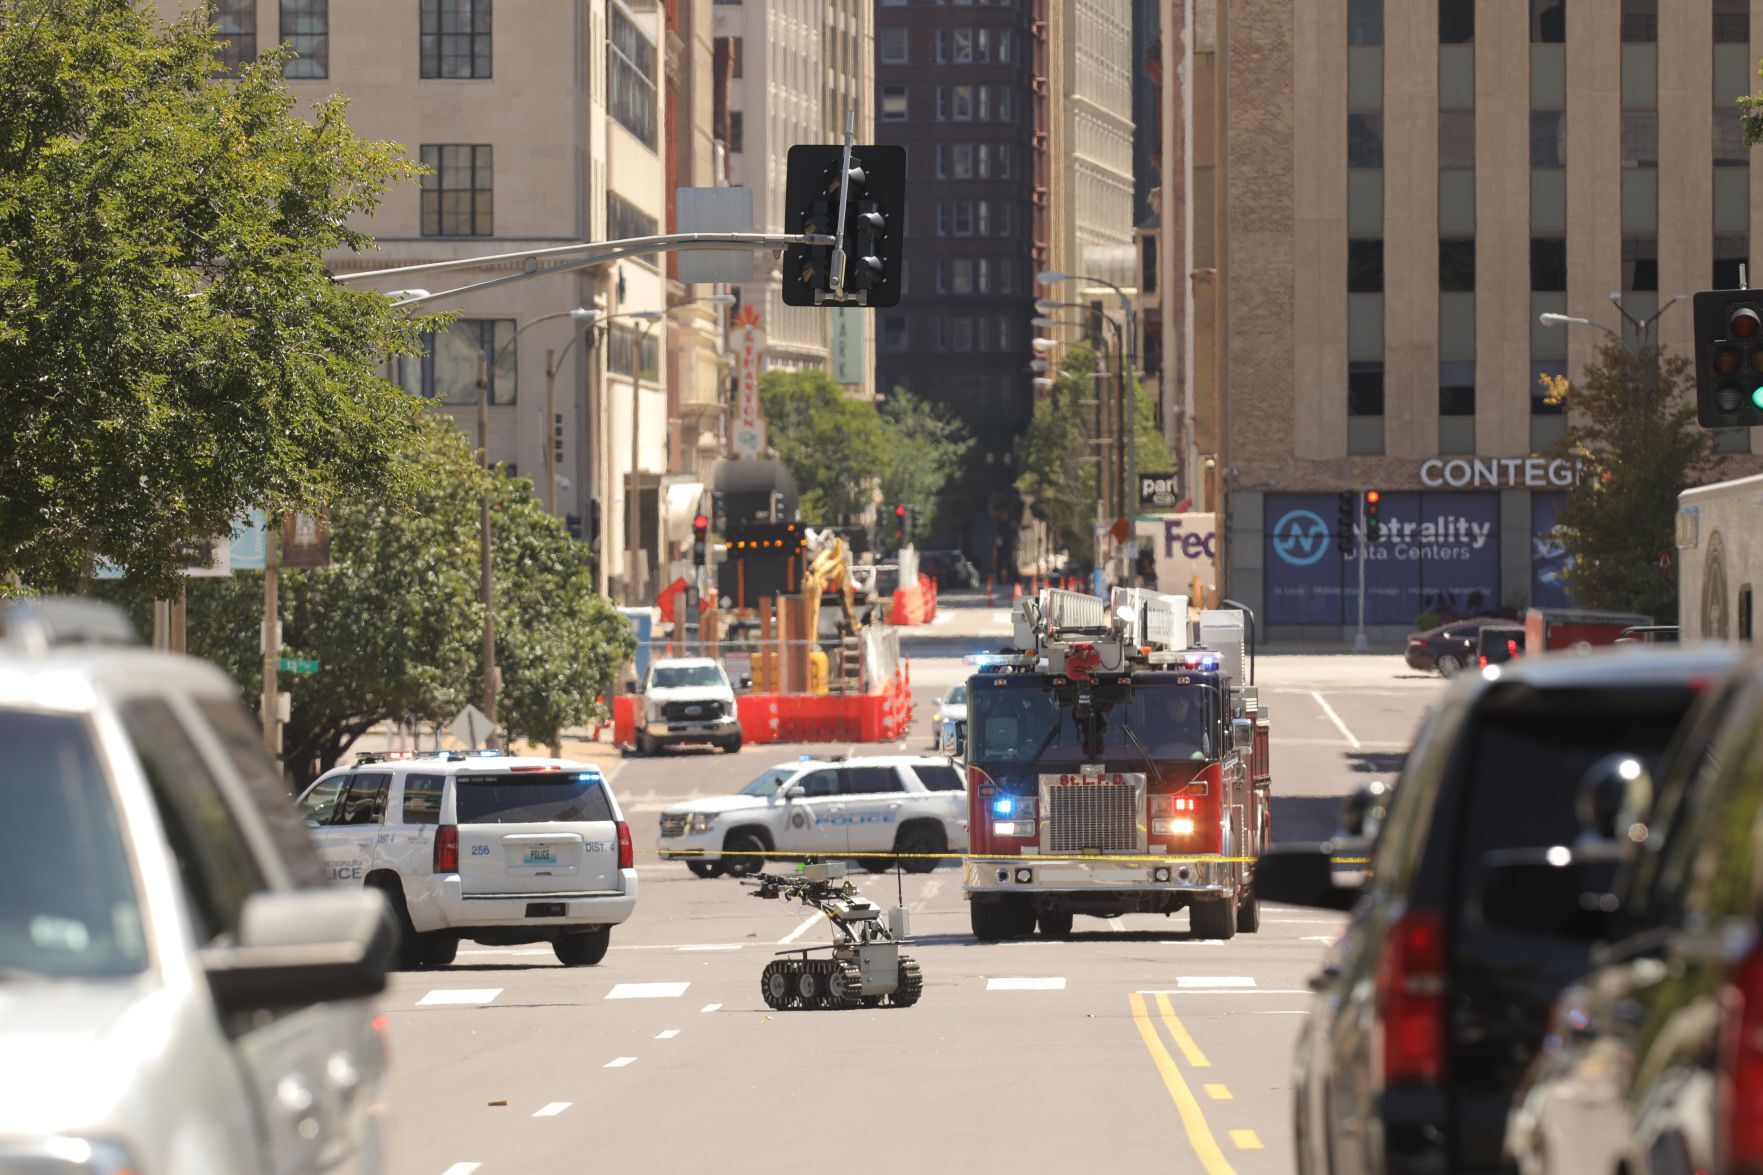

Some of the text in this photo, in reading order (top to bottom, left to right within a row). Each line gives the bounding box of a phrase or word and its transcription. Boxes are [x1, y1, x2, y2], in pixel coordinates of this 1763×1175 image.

[1394, 543, 1471, 560] Centers
[815, 810, 897, 826] POLICE
[471, 844, 490, 856] 256
